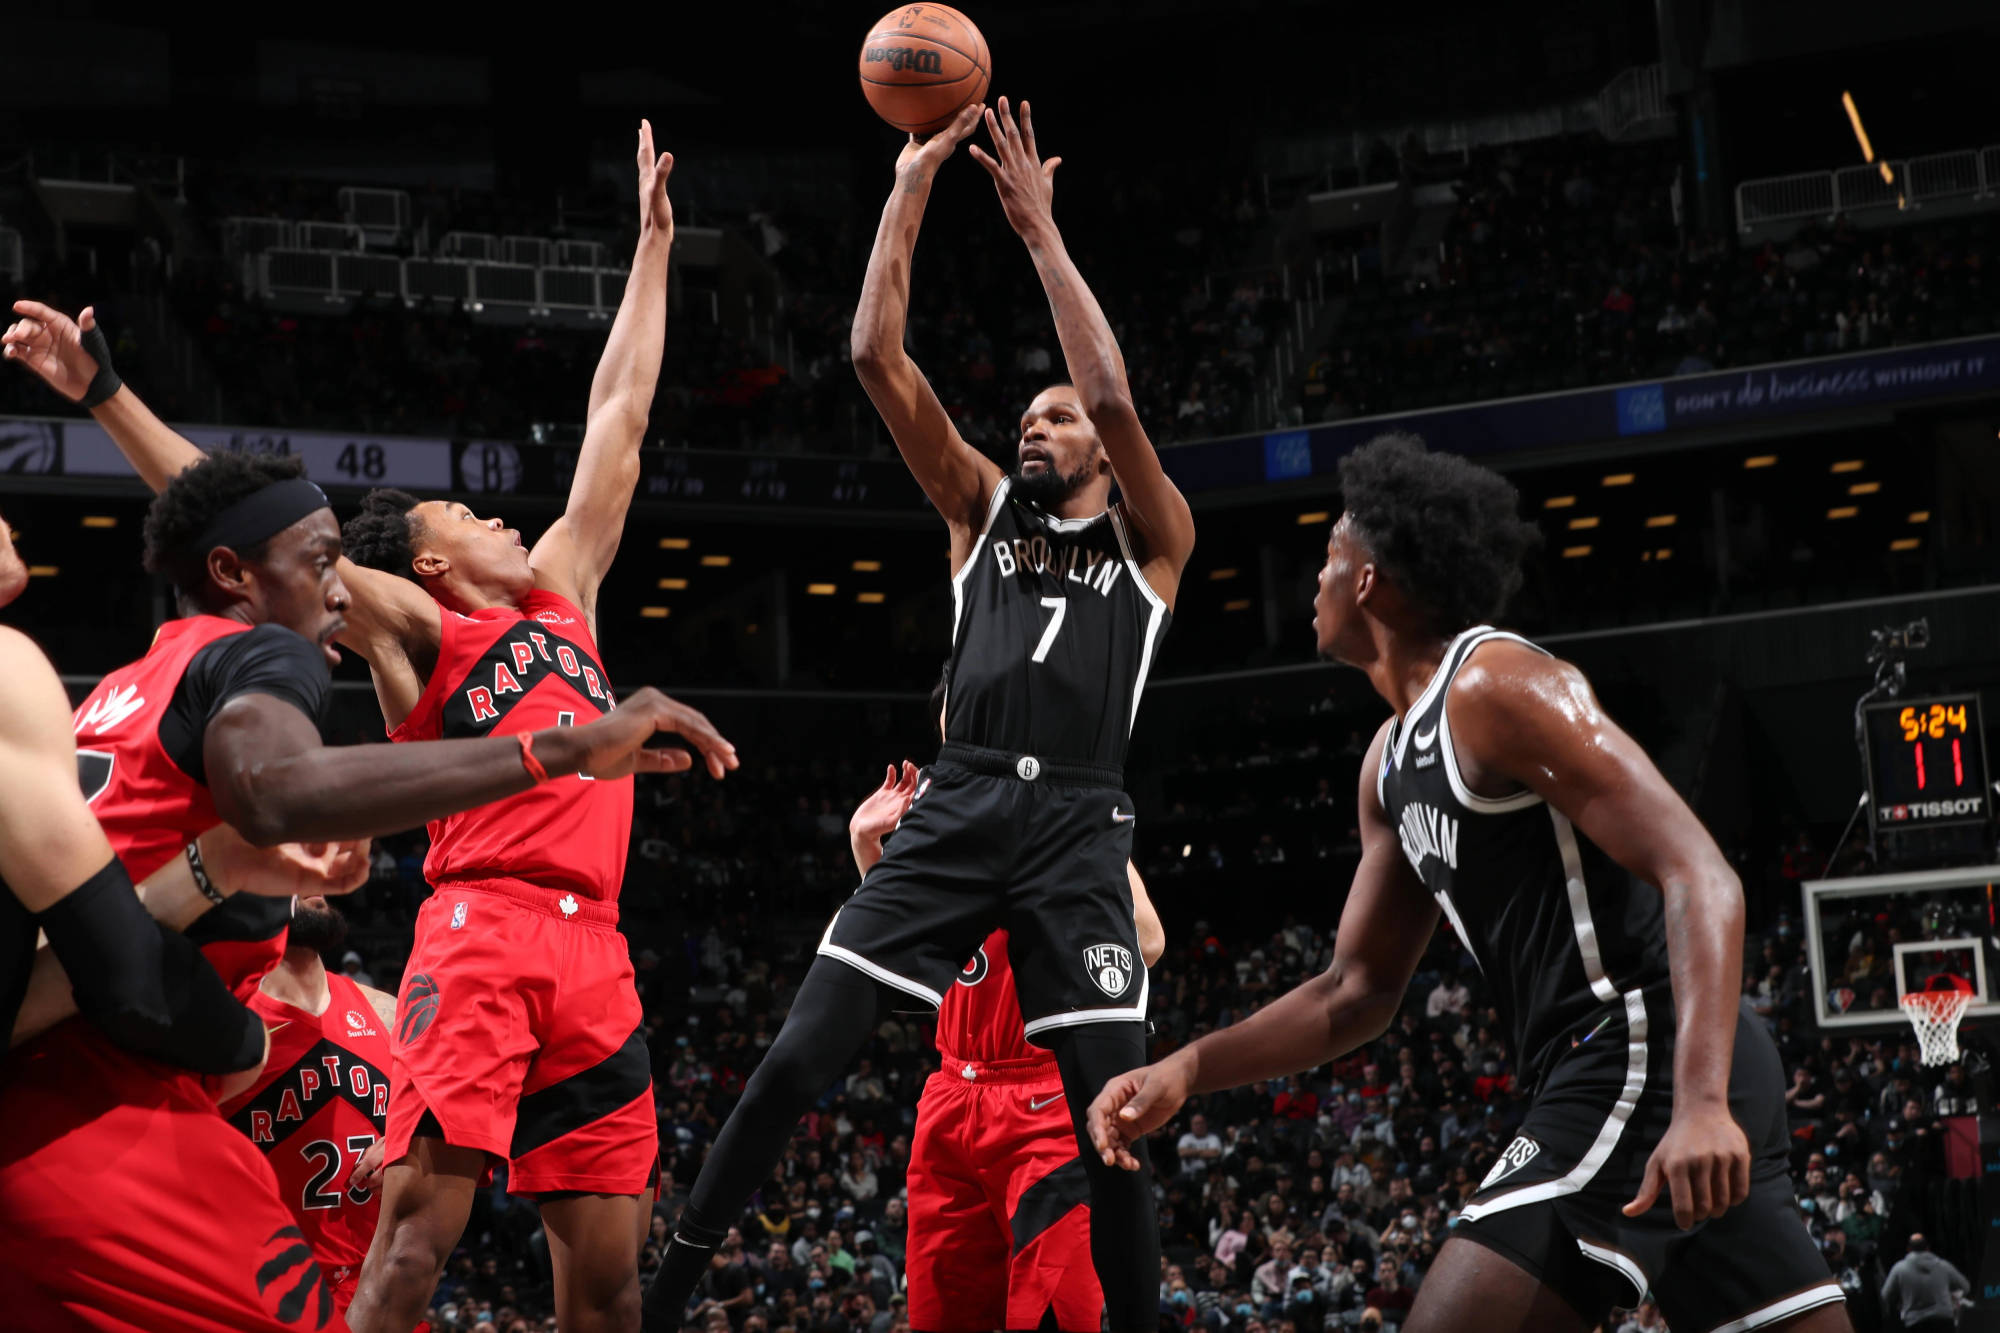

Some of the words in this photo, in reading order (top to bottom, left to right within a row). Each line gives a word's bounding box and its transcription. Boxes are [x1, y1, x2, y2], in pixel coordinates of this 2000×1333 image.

[865, 46, 943, 75] Wilson
[1737, 373, 1763, 407] do
[1768, 367, 1870, 404] business
[1873, 363, 1961, 388] WITHOUT
[1966, 356, 1985, 374] IT
[336, 443, 386, 479] 48
[1032, 597, 1066, 663] 7
[1899, 703, 1967, 742] 5:24
[1913, 737, 1965, 790] 11
[1908, 797, 1982, 819] TISSOT
[1087, 946, 1131, 972] NETS
